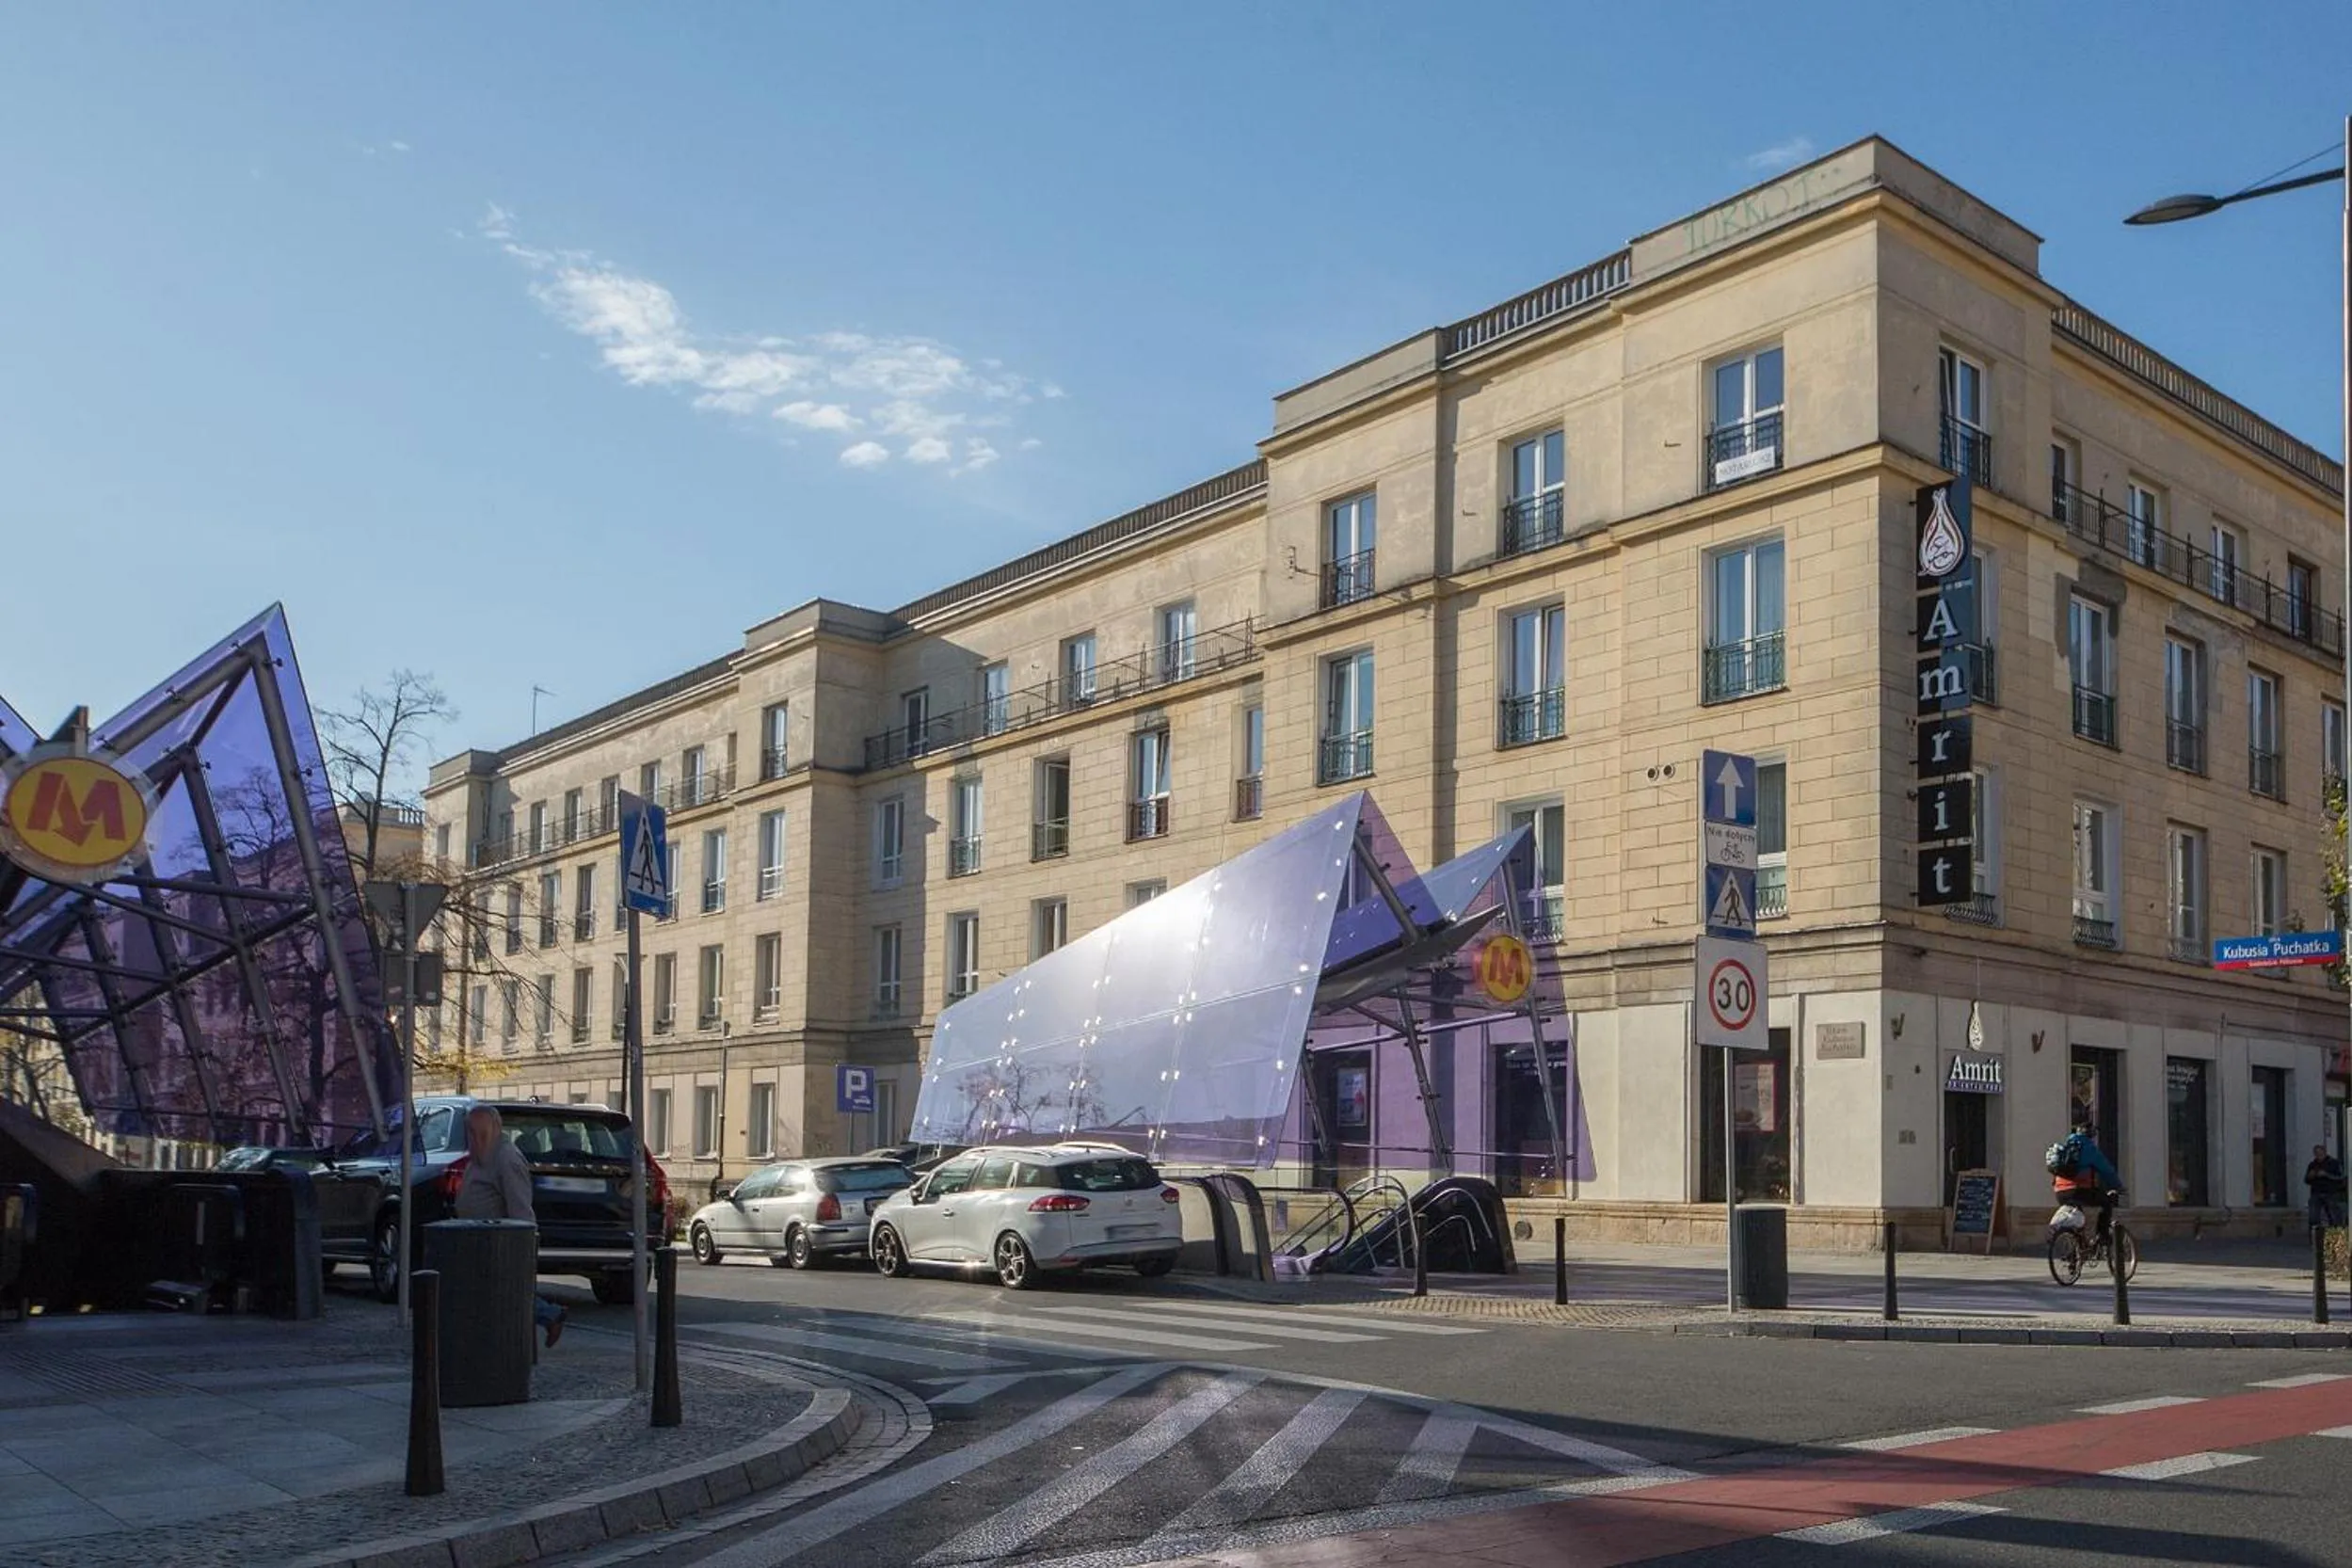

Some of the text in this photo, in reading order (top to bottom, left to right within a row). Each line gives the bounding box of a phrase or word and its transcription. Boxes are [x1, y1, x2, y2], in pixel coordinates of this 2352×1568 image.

[1919, 598, 1963, 894] Amrit
[26, 770, 127, 847] M
[1707, 826, 1722, 838] Nie
[2223, 944, 2268, 958] Kubusia
[2273, 939, 2330, 955] Puchatka
[1717, 977, 1751, 1012] 30
[1950, 1054, 2002, 1083] Amrit
[845, 1069, 867, 1098] P
